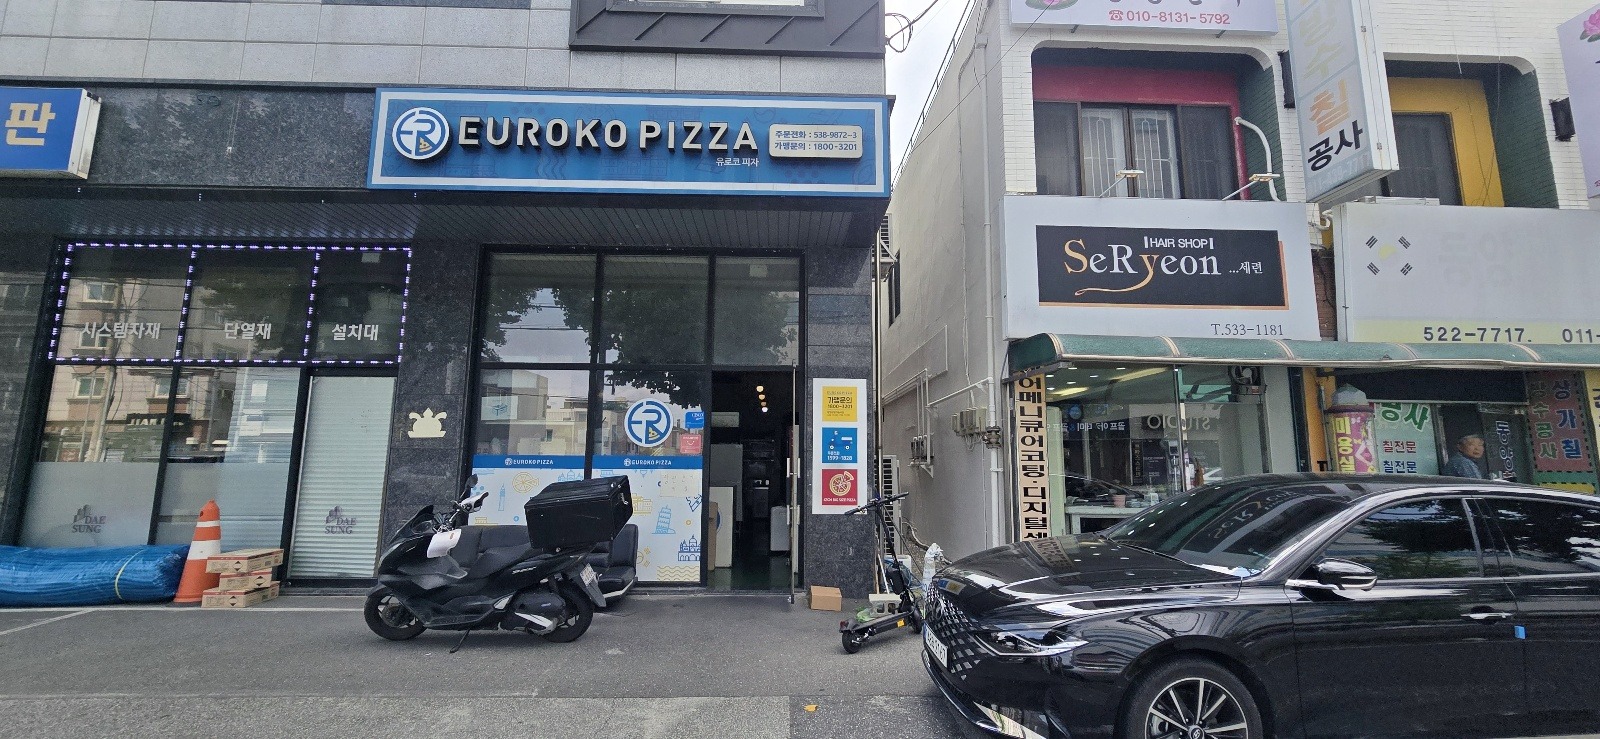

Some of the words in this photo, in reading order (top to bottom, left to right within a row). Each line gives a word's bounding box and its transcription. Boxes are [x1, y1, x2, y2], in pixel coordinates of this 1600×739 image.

[1127, 10, 1230, 25] 010-8131-5792
[5, 102, 56, 146] 판
[458, 116, 628, 149] EUROKO
[639, 120, 759, 151] PIZZA
[775, 130, 806, 139] 주문전화
[775, 142, 806, 151] 가맹문의
[814, 143, 857, 151] 1800-3201
[1307, 119, 1364, 172] 공사
[716, 157, 741, 166] 유로코
[742, 157, 760, 168] 피자
[1150, 237, 1175, 248] HAIR
[1179, 238, 1208, 249] SHOP
[1063, 238, 1222, 295] SeRyeon
[82, 321, 161, 339] 시스템자재
[224, 322, 272, 340] 단열재
[331, 323, 379, 341] 설치대
[1211, 323, 1284, 337] T.533-1181
[1382, 440, 1417, 453] 칠전문
[1383, 460, 1418, 474] 칠전문
[84, 515, 107, 524] DAE
[335, 517, 357, 526] DAE
[71, 524, 102, 533] SUNG
[324, 525, 354, 534] SUNG
